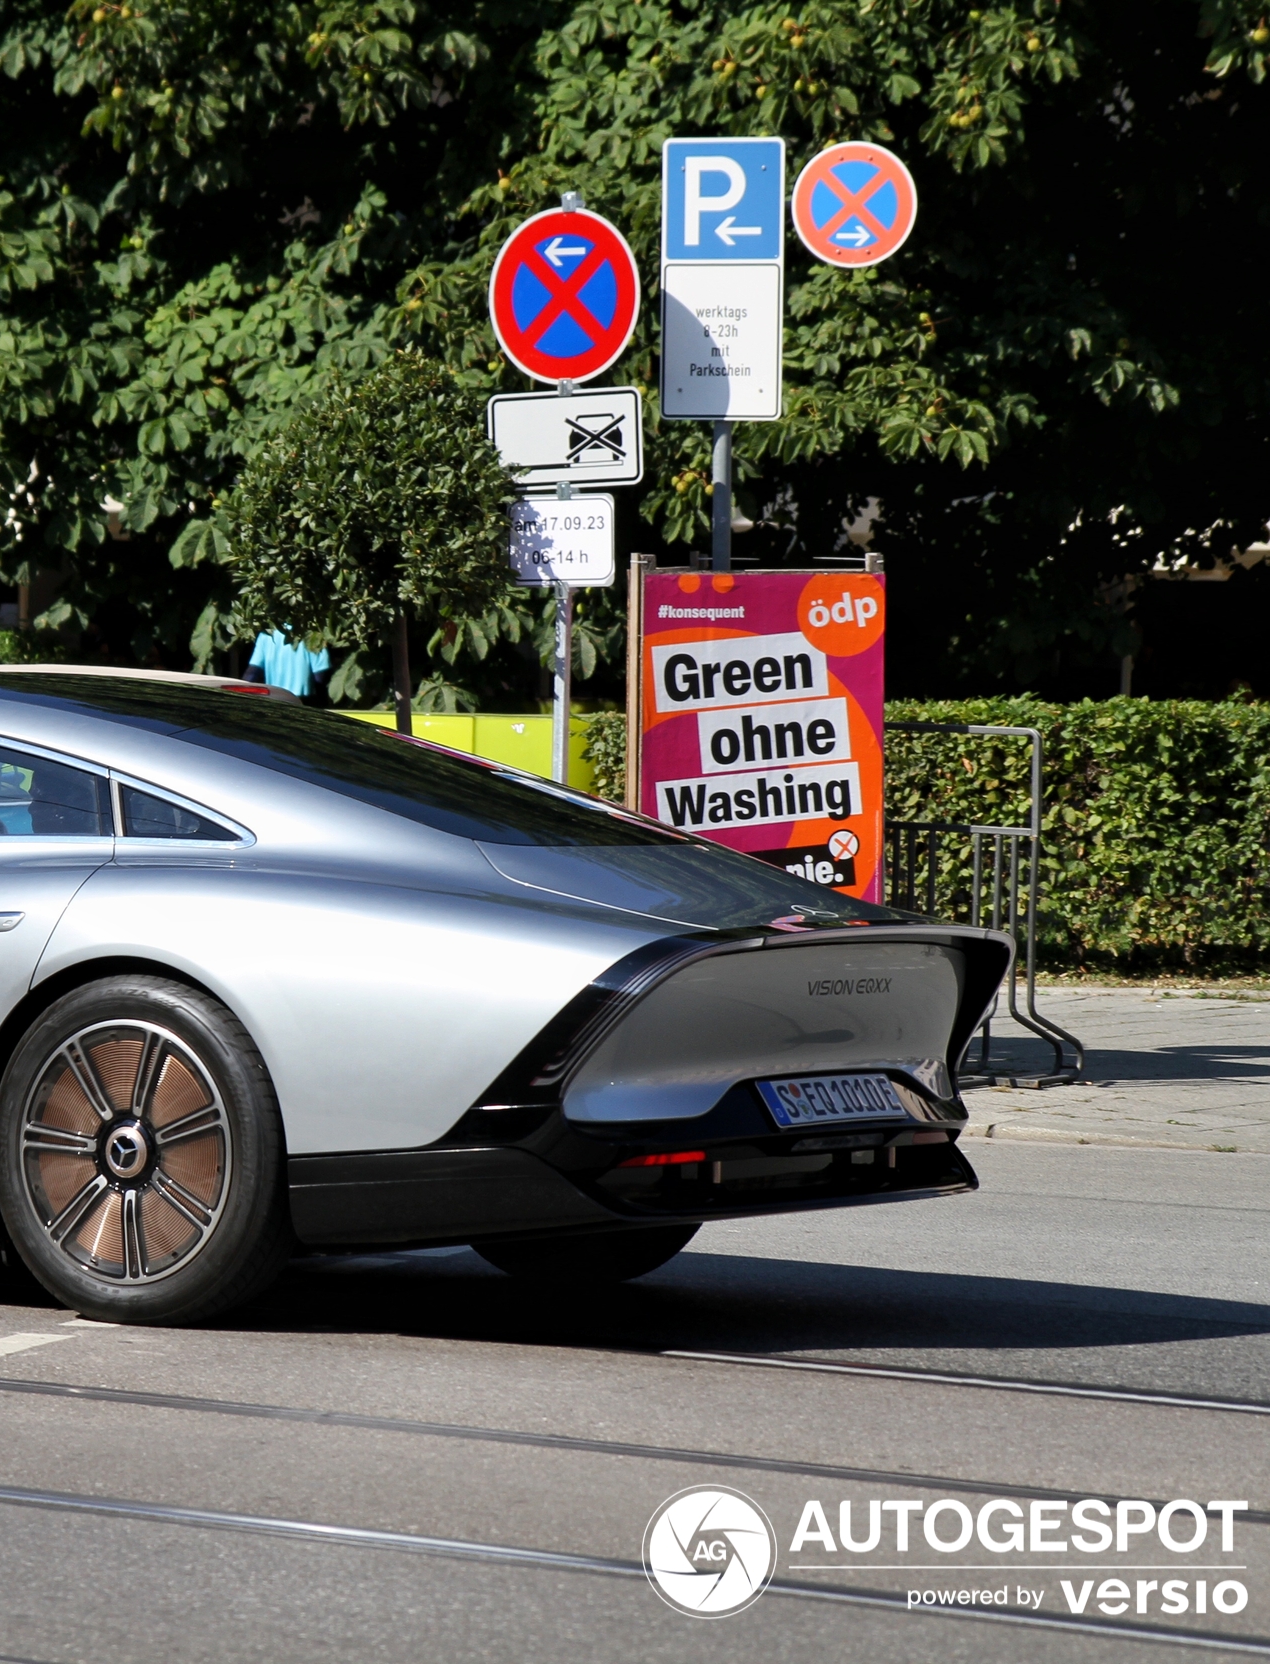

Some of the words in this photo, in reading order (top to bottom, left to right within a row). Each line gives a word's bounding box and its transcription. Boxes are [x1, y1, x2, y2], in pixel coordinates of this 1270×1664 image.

[684, 155, 747, 246] P
[695, 305, 748, 321] werktags
[711, 344, 730, 357] mit
[690, 363, 751, 377] Parkschein
[514, 520, 537, 532] am
[541, 515, 606, 531] 17.09.23
[532, 550, 574, 565] 06-14
[579, 549, 589, 563] h
[658, 605, 745, 621] #konsequent
[808, 592, 878, 628] ödp
[664, 652, 814, 702] Green
[711, 714, 837, 765] ohne
[665, 773, 852, 827] Washing
[808, 979, 854, 996] VISION
[855, 978, 893, 994] EQXX
